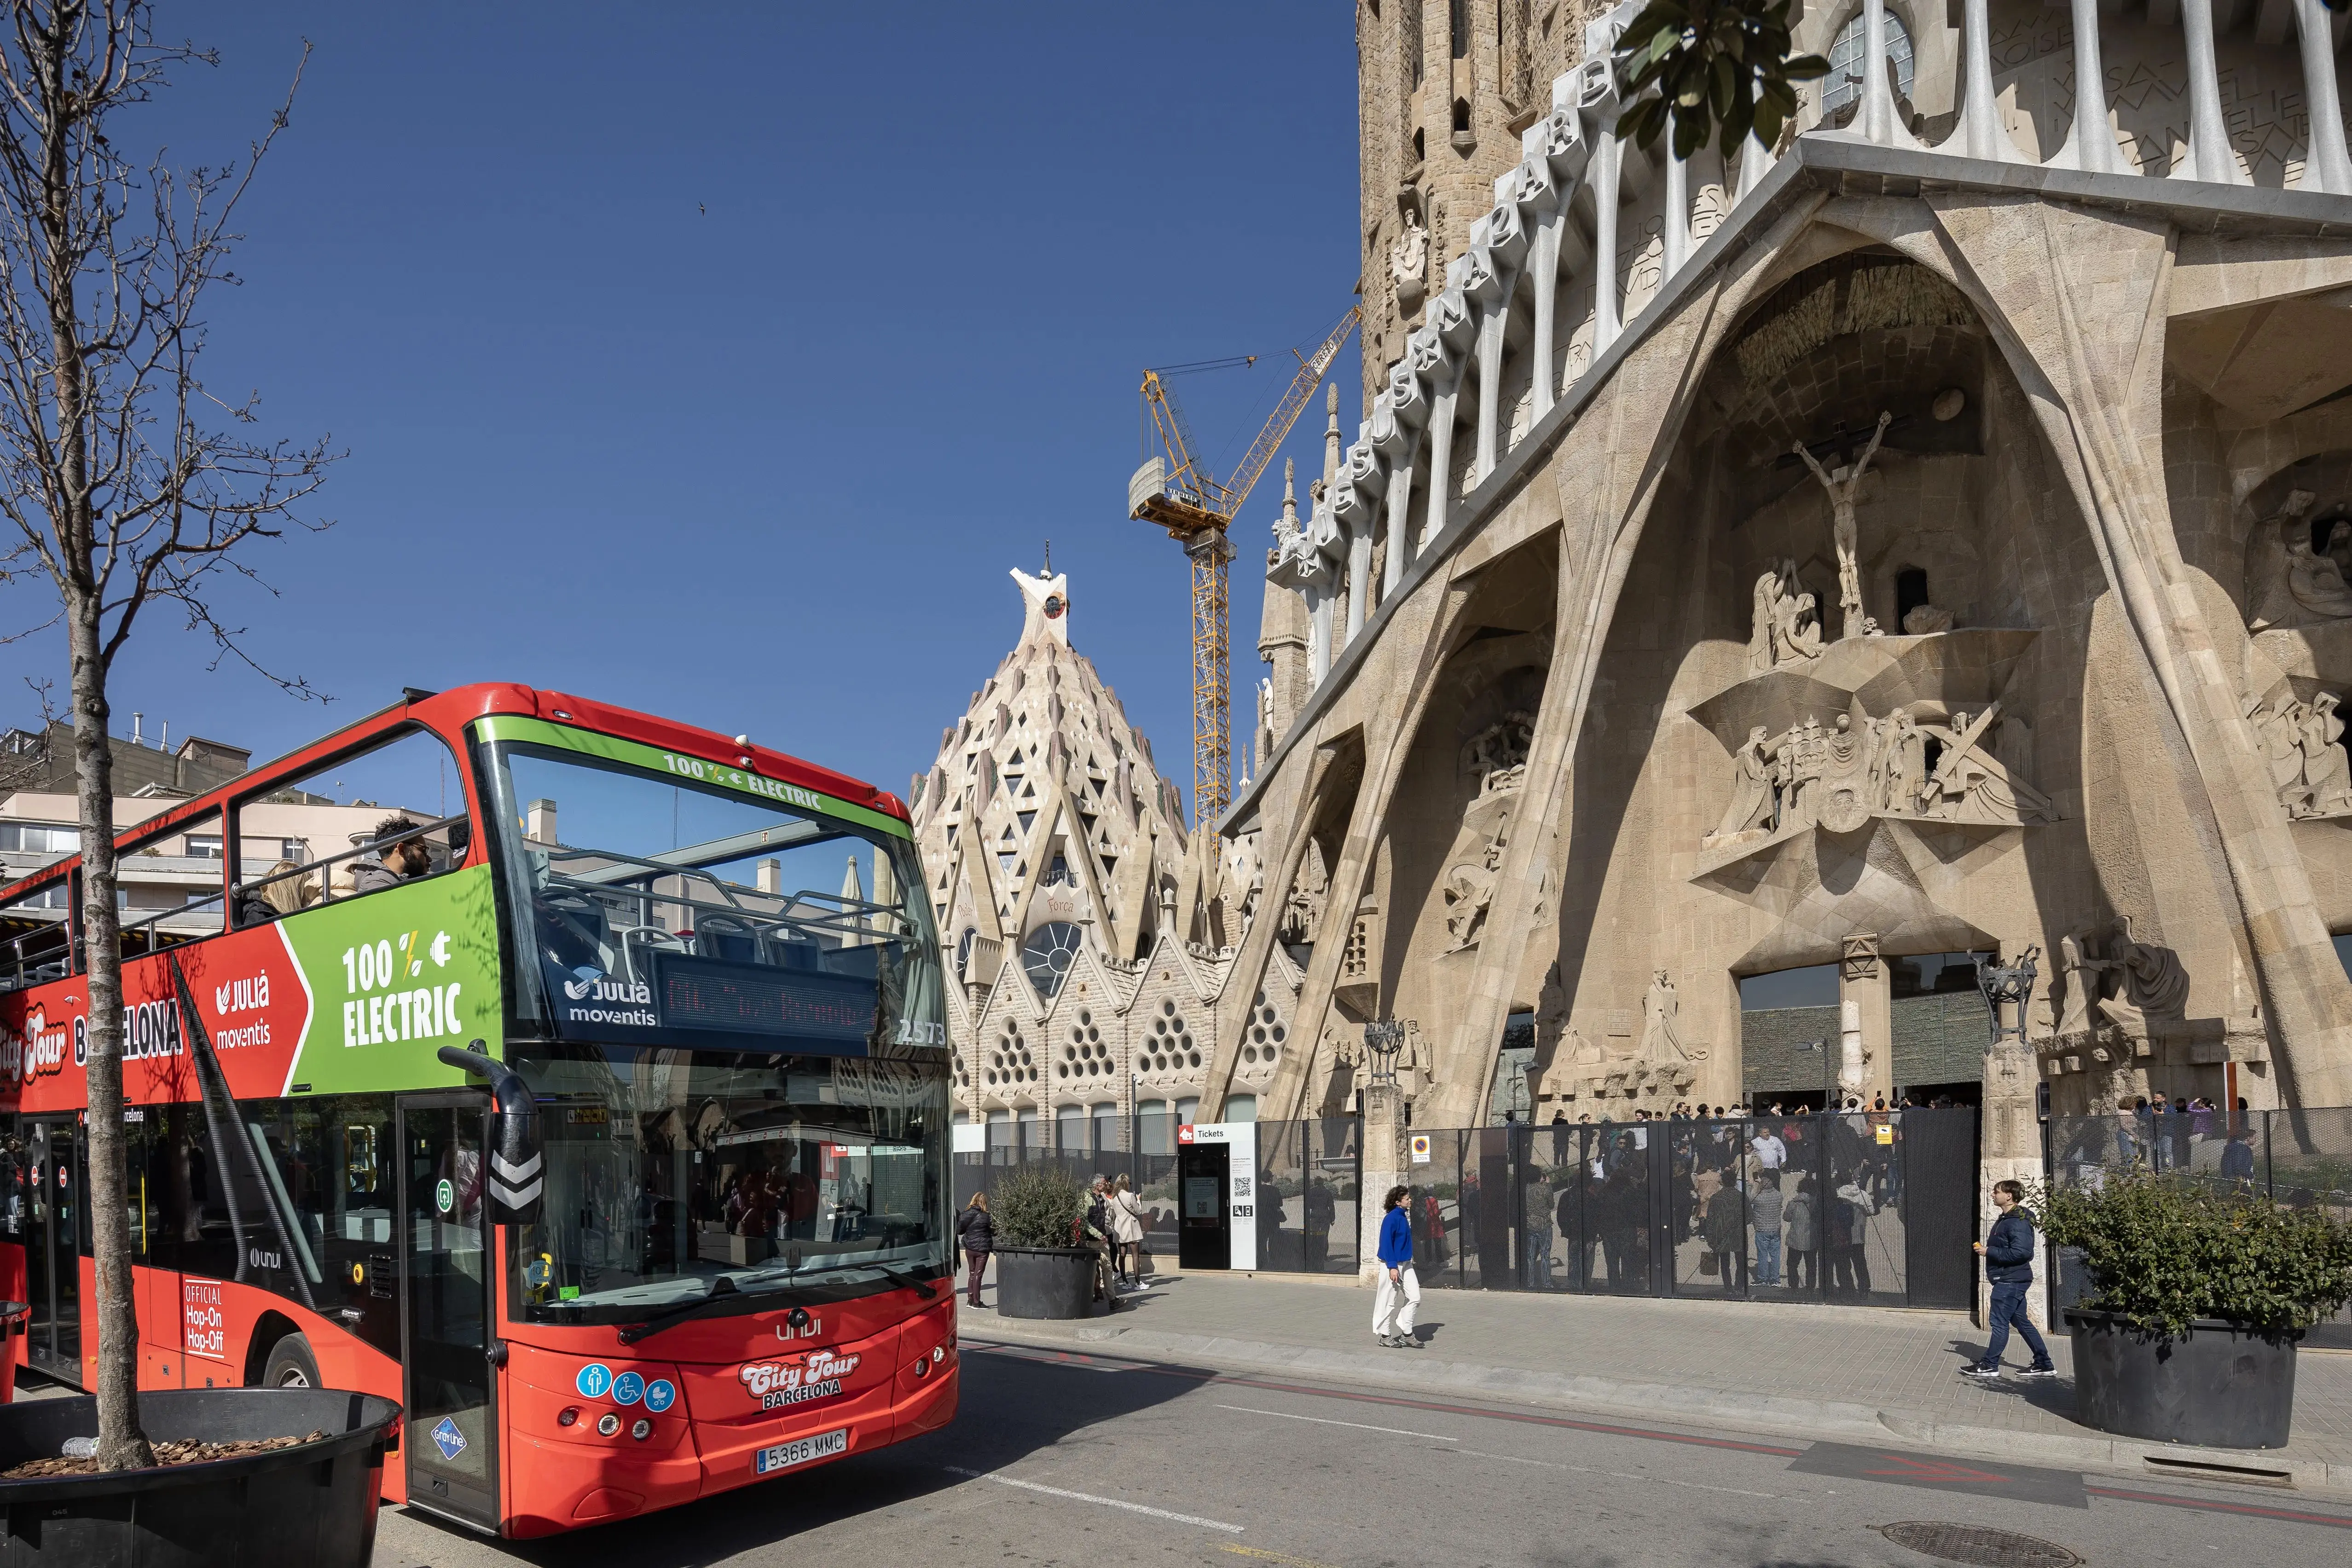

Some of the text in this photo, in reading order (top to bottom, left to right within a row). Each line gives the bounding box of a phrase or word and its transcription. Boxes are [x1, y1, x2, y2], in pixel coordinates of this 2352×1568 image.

[1435, 203, 1447, 297] APOSTO
[1312, 342, 1334, 369] CEREZO
[1319, 370, 1413, 543] JESUS
[747, 775, 822, 810] ELECTRIC
[957, 903, 973, 919] Poder
[1047, 897, 1074, 913] Força
[343, 982, 462, 1047] ELECTRIC
[569, 1008, 656, 1026] moventis
[0, 998, 183, 1082] ity Tour BELONA
[217, 1017, 271, 1050] moventis
[899, 1019, 947, 1045] 2573
[125, 1108, 143, 1122] rcelona
[185, 1285, 222, 1305] OFFICIAL
[186, 1305, 222, 1330] Hop-On
[188, 1327, 224, 1352] Hop-Off
[742, 1352, 858, 1394] City Tour
[763, 1379, 841, 1410] BARCELONA
[770, 1442, 809, 1467] 5366
[815, 1434, 842, 1455] MMC
